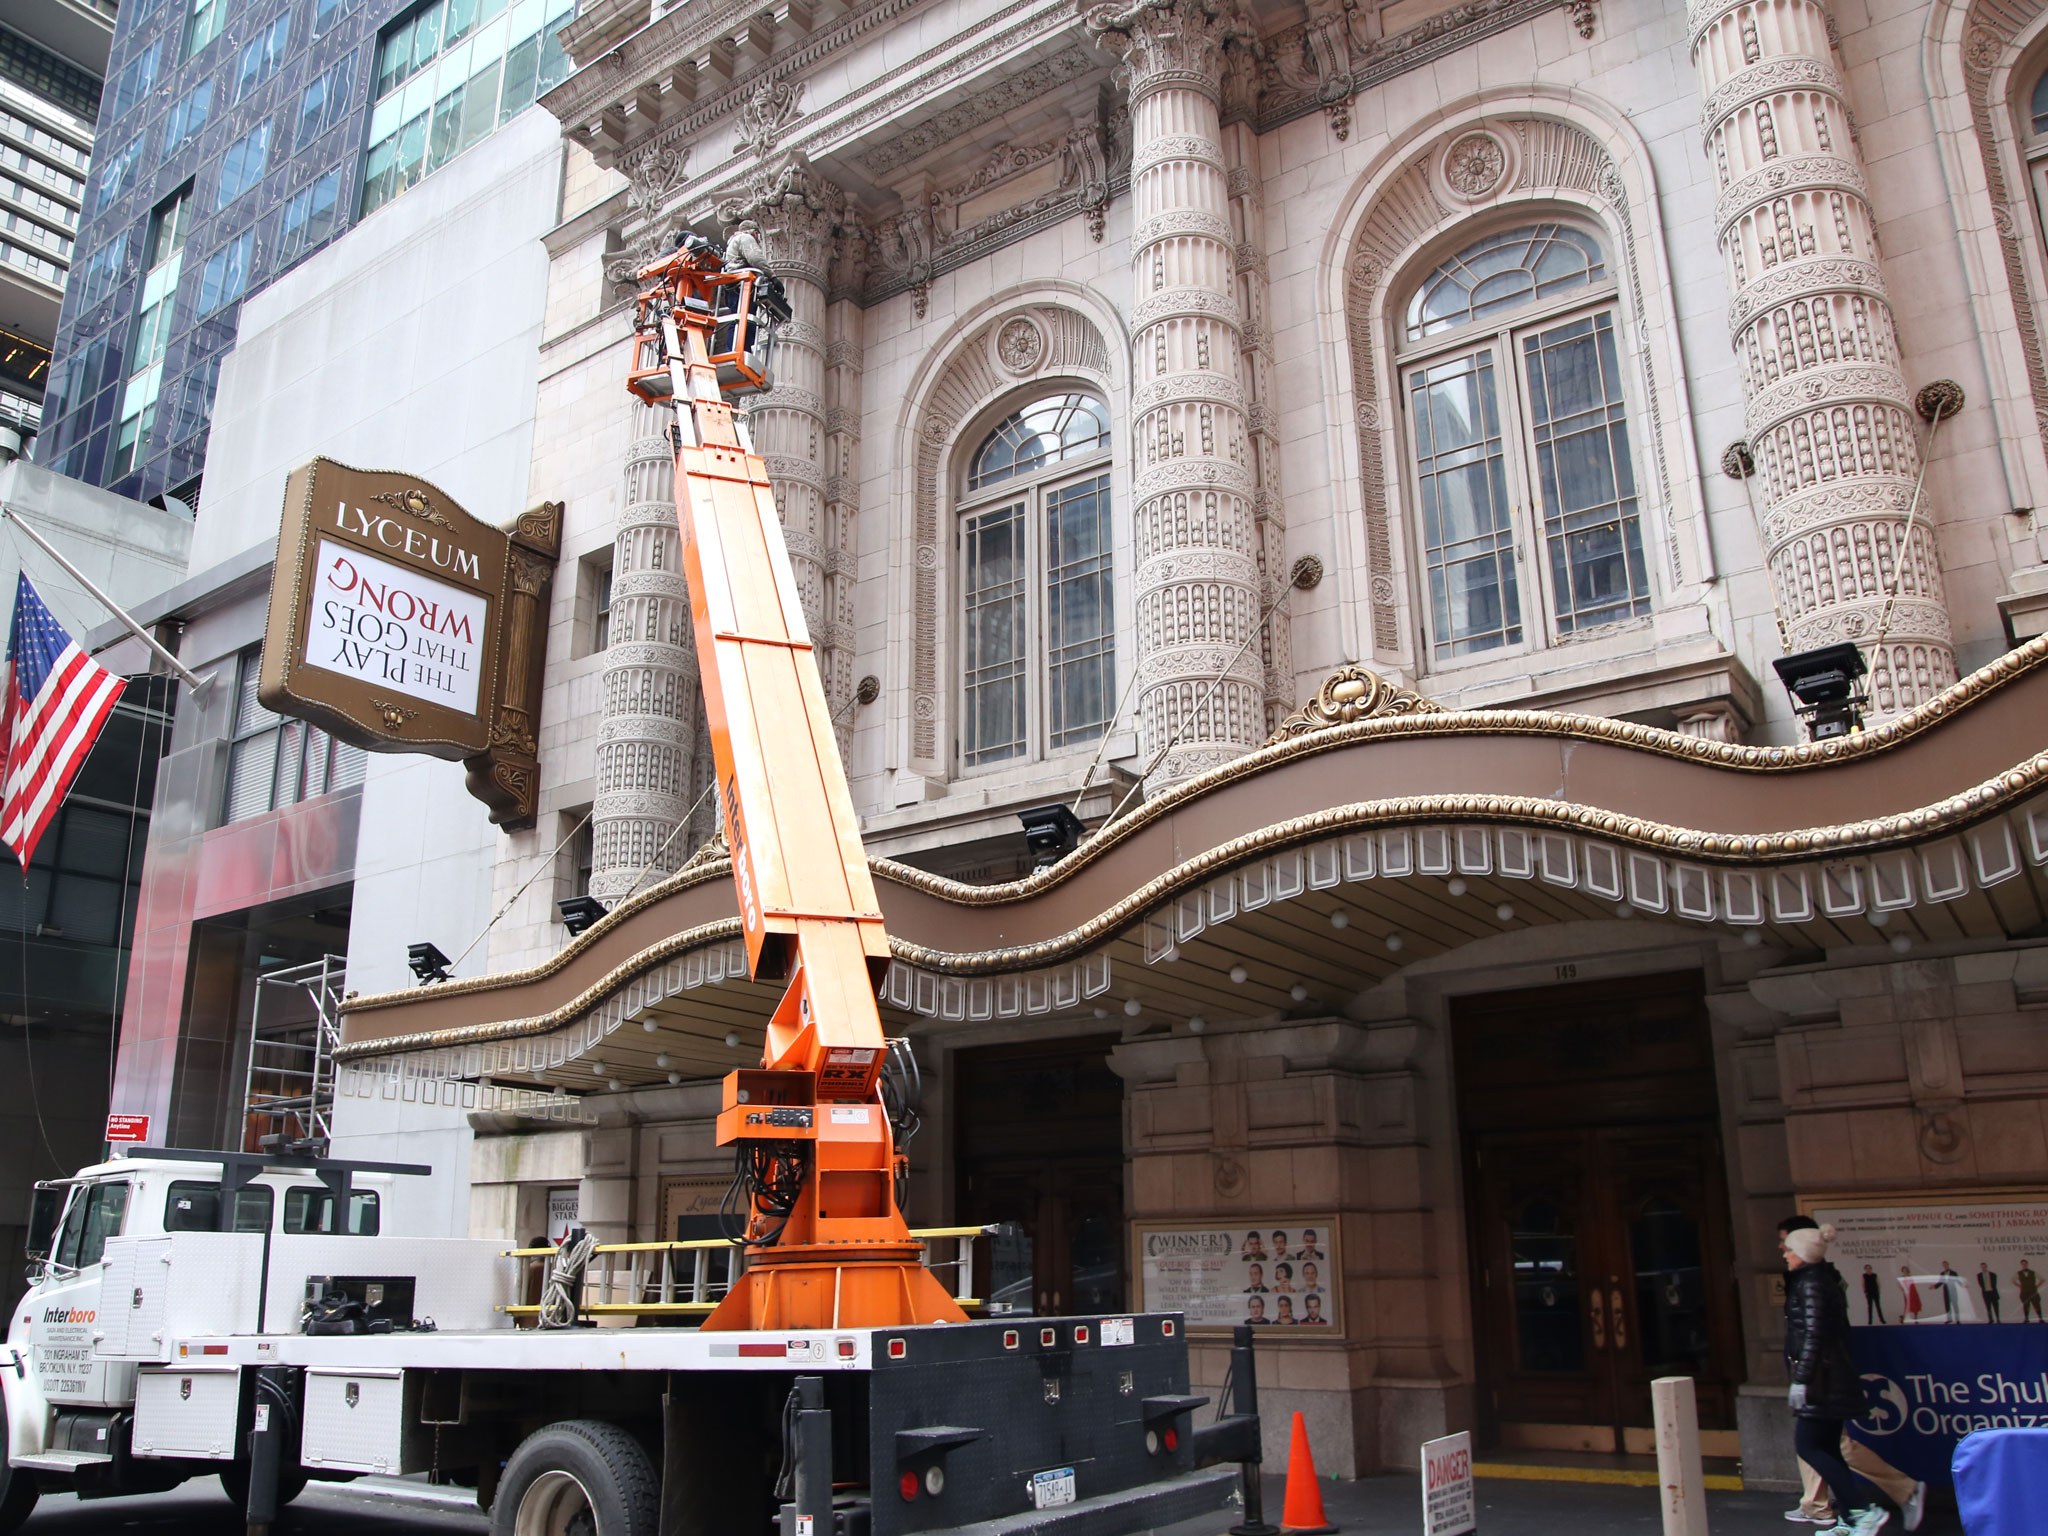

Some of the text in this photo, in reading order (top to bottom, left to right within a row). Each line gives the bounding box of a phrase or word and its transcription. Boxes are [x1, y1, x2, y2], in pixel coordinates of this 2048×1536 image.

[336, 501, 481, 580] LYCEUM
[327, 556, 474, 644] WRONG
[323, 600, 470, 672] THAT GOES
[330, 640, 456, 694] THE PLAY
[726, 774, 757, 932] Interboro
[1556, 963, 1577, 980] 149
[823, 1070, 867, 1079] RX
[555, 1212, 578, 1220] STARS
[1906, 1212, 1941, 1222] AVENUE
[1944, 1212, 1954, 1221] Q
[1968, 1210, 2030, 1220] SOMETHING
[2032, 1209, 2048, 1218] RO
[2006, 1218, 2046, 1227] ABRAMS
[1158, 1234, 1222, 1247] WINNER!
[43, 1306, 96, 1324] Interboro
[54, 1349, 80, 1360] INGRAHAM
[79, 1363, 92, 1375] 11237
[44, 1379, 60, 1392] USDOT
[1905, 1374, 1970, 1404] The
[1428, 1449, 1469, 1490] DANGER
